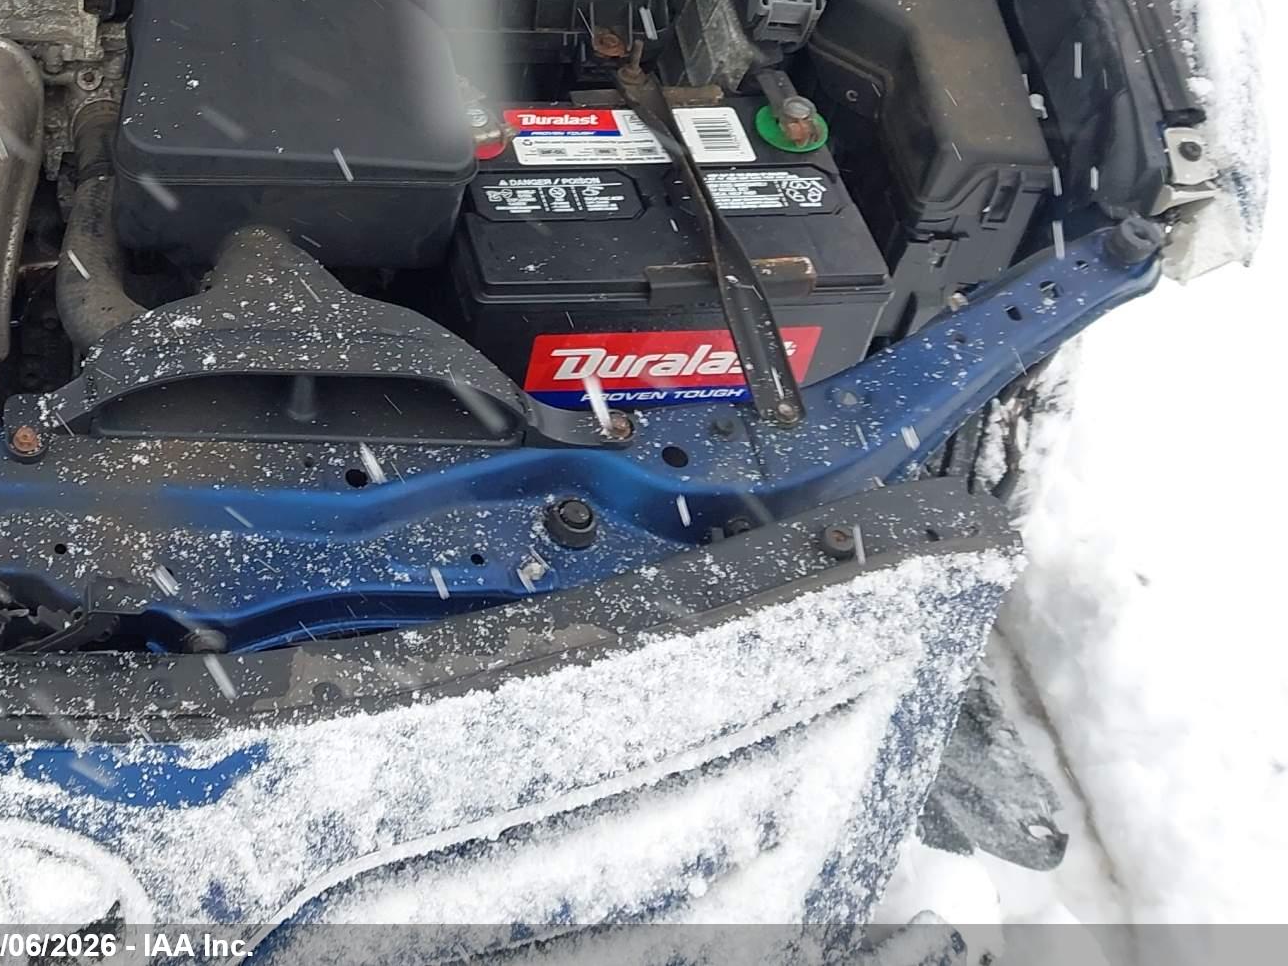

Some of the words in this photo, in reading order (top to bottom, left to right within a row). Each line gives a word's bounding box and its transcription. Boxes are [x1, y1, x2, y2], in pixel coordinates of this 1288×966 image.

[517, 114, 598, 126] Duralast
[580, 391, 668, 402] POVEN
[673, 389, 746, 399] TOUGH
